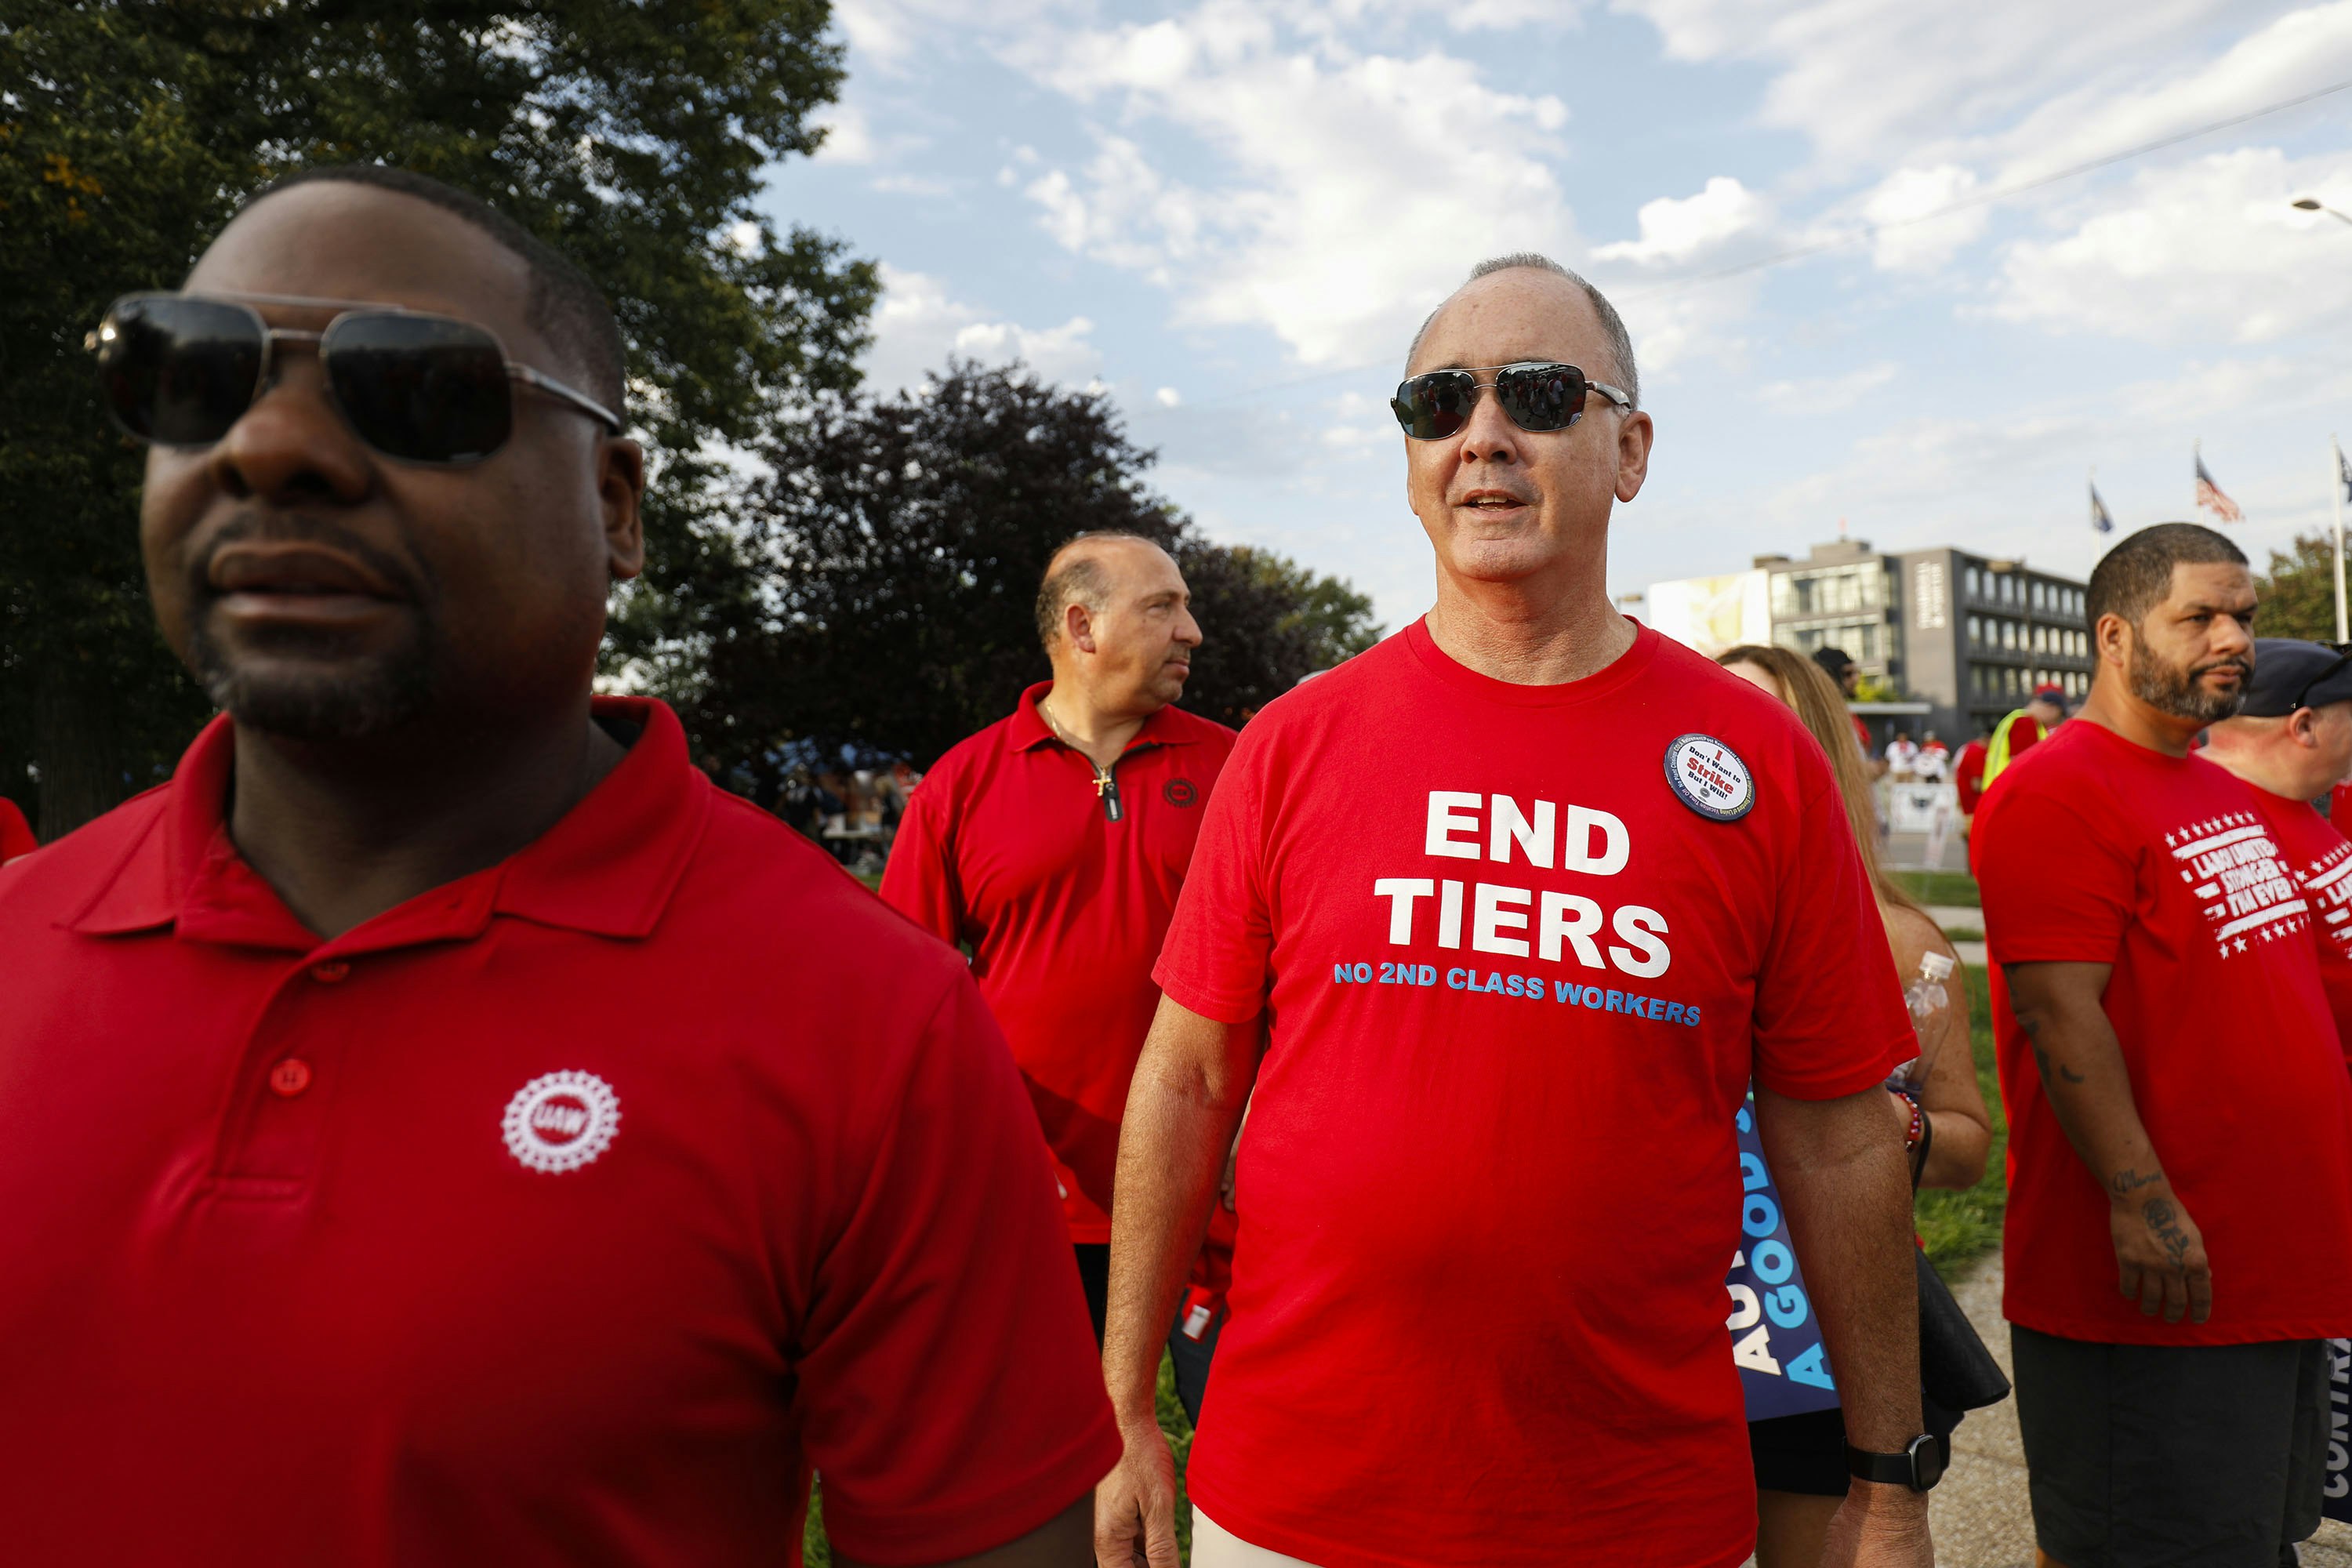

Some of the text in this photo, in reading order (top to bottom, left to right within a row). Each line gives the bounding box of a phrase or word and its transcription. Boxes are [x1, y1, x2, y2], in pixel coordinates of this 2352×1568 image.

[1689, 746, 1741, 783] Don't Want to
[1715, 750, 1722, 761] I
[1686, 757, 1734, 795] Strike
[1687, 771, 1702, 784] But
[1709, 784, 1728, 800] Will!
[1689, 795, 1700, 806] Time
[1700, 803, 1720, 815] Vacation
[1425, 790, 1630, 876] END
[1374, 878, 1671, 978] TIERS
[1334, 962, 1700, 1027] NO 2ND CLASS WORKERS
[1740, 1151, 1835, 1391] A GOOD
